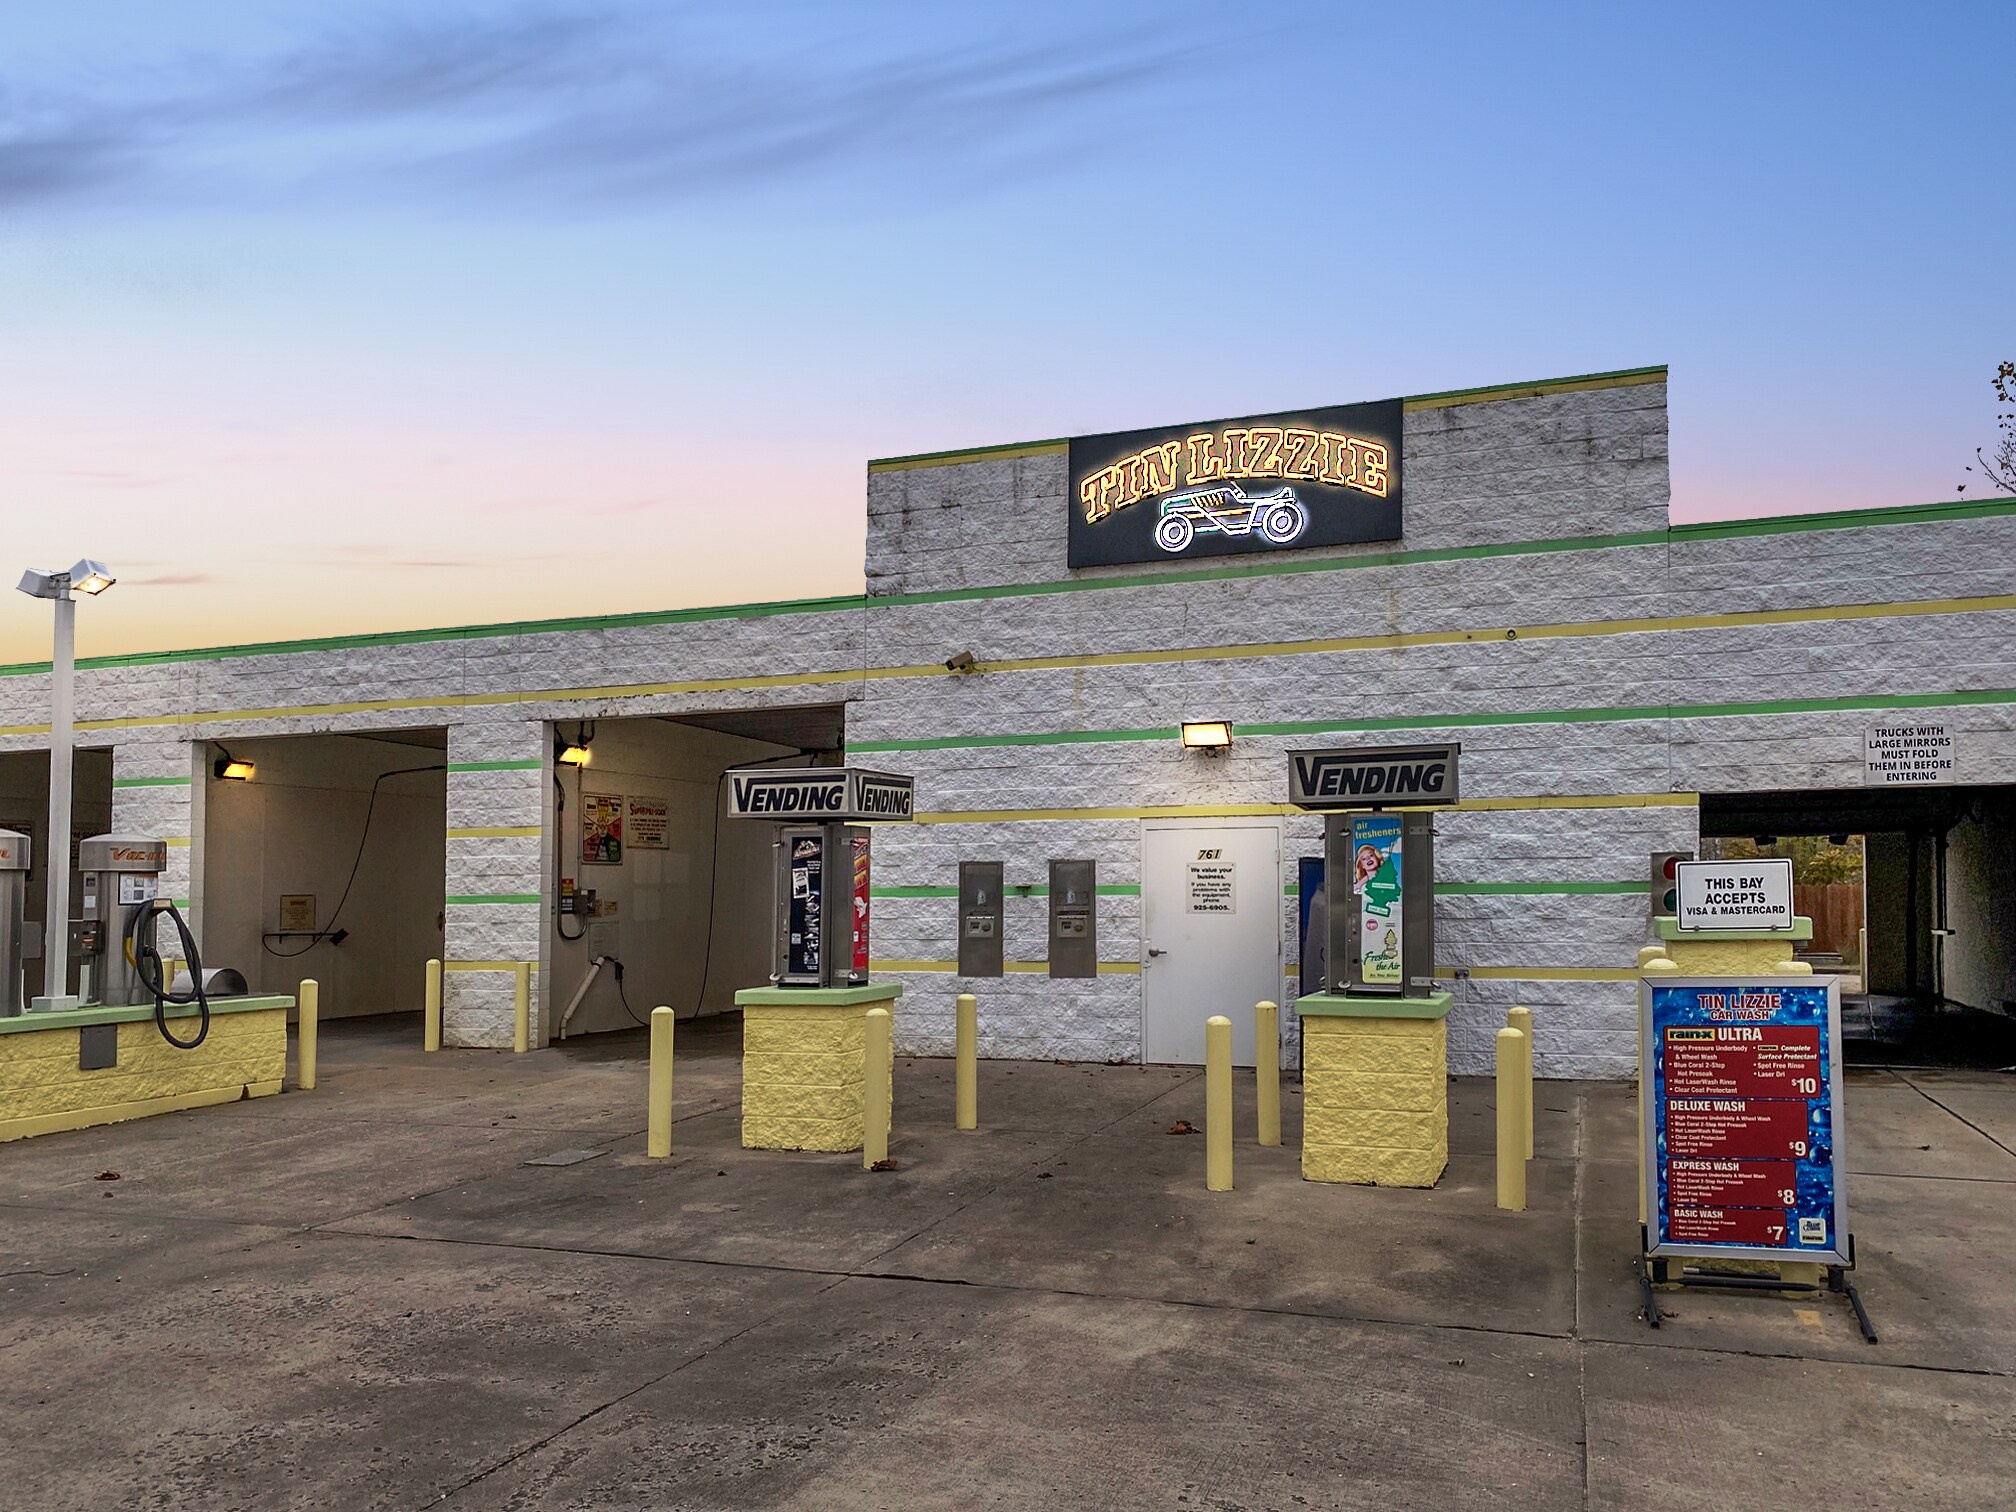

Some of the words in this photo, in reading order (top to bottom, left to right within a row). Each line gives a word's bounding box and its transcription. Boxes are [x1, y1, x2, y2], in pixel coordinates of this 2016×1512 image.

[1080, 441, 1182, 524] TIN
[1186, 427, 1389, 498] LIZZIE
[1874, 728, 1914, 738] TRUCKS
[1916, 726, 1944, 736] WITH
[1868, 738, 1902, 749] LARGE
[1904, 737, 1951, 748] MIRRORS
[1881, 750, 1909, 760] MUST
[1912, 749, 1939, 758] FOLD
[1868, 761, 1898, 771] THEM
[1900, 760, 1912, 770] IN
[1914, 759, 1952, 770] BEFORE
[1296, 751, 1448, 796] VENDING
[1886, 771, 1938, 782] ENTERING
[734, 775, 846, 812] VENDING
[856, 776, 911, 814] VENDING
[1356, 822, 1368, 830] air
[1355, 828, 1401, 840] fresheners
[1198, 850, 1220, 860] 761
[1705, 878, 1735, 890] THIS
[1740, 877, 1764, 889] BAY
[1705, 892, 1766, 905] ACCEPTS
[1686, 907, 1708, 916] VISA
[1711, 906, 1718, 915] &
[1720, 905, 1786, 915] MASTERCARD
[1376, 962, 1387, 971] the
[1388, 962, 1400, 970] Air
[1697, 994, 1726, 1010] TIN
[1730, 994, 1781, 1010] LIZZIE
[1710, 1010, 1734, 1020] CAR
[1736, 1010, 1770, 1020] WASH
[1718, 1028, 1763, 1041] ULTRA
[1791, 1078, 1816, 1093] $10
[1670, 1101, 1711, 1111] DELUXE
[1714, 1101, 1746, 1111] WASH
[1789, 1141, 1806, 1156] $9
[1673, 1161, 1711, 1170] EXPRESS
[1714, 1162, 1739, 1171] WASH
[1778, 1189, 1794, 1204] $8
[1674, 1210, 1698, 1218] BASIC
[1767, 1226, 1784, 1240] $7
